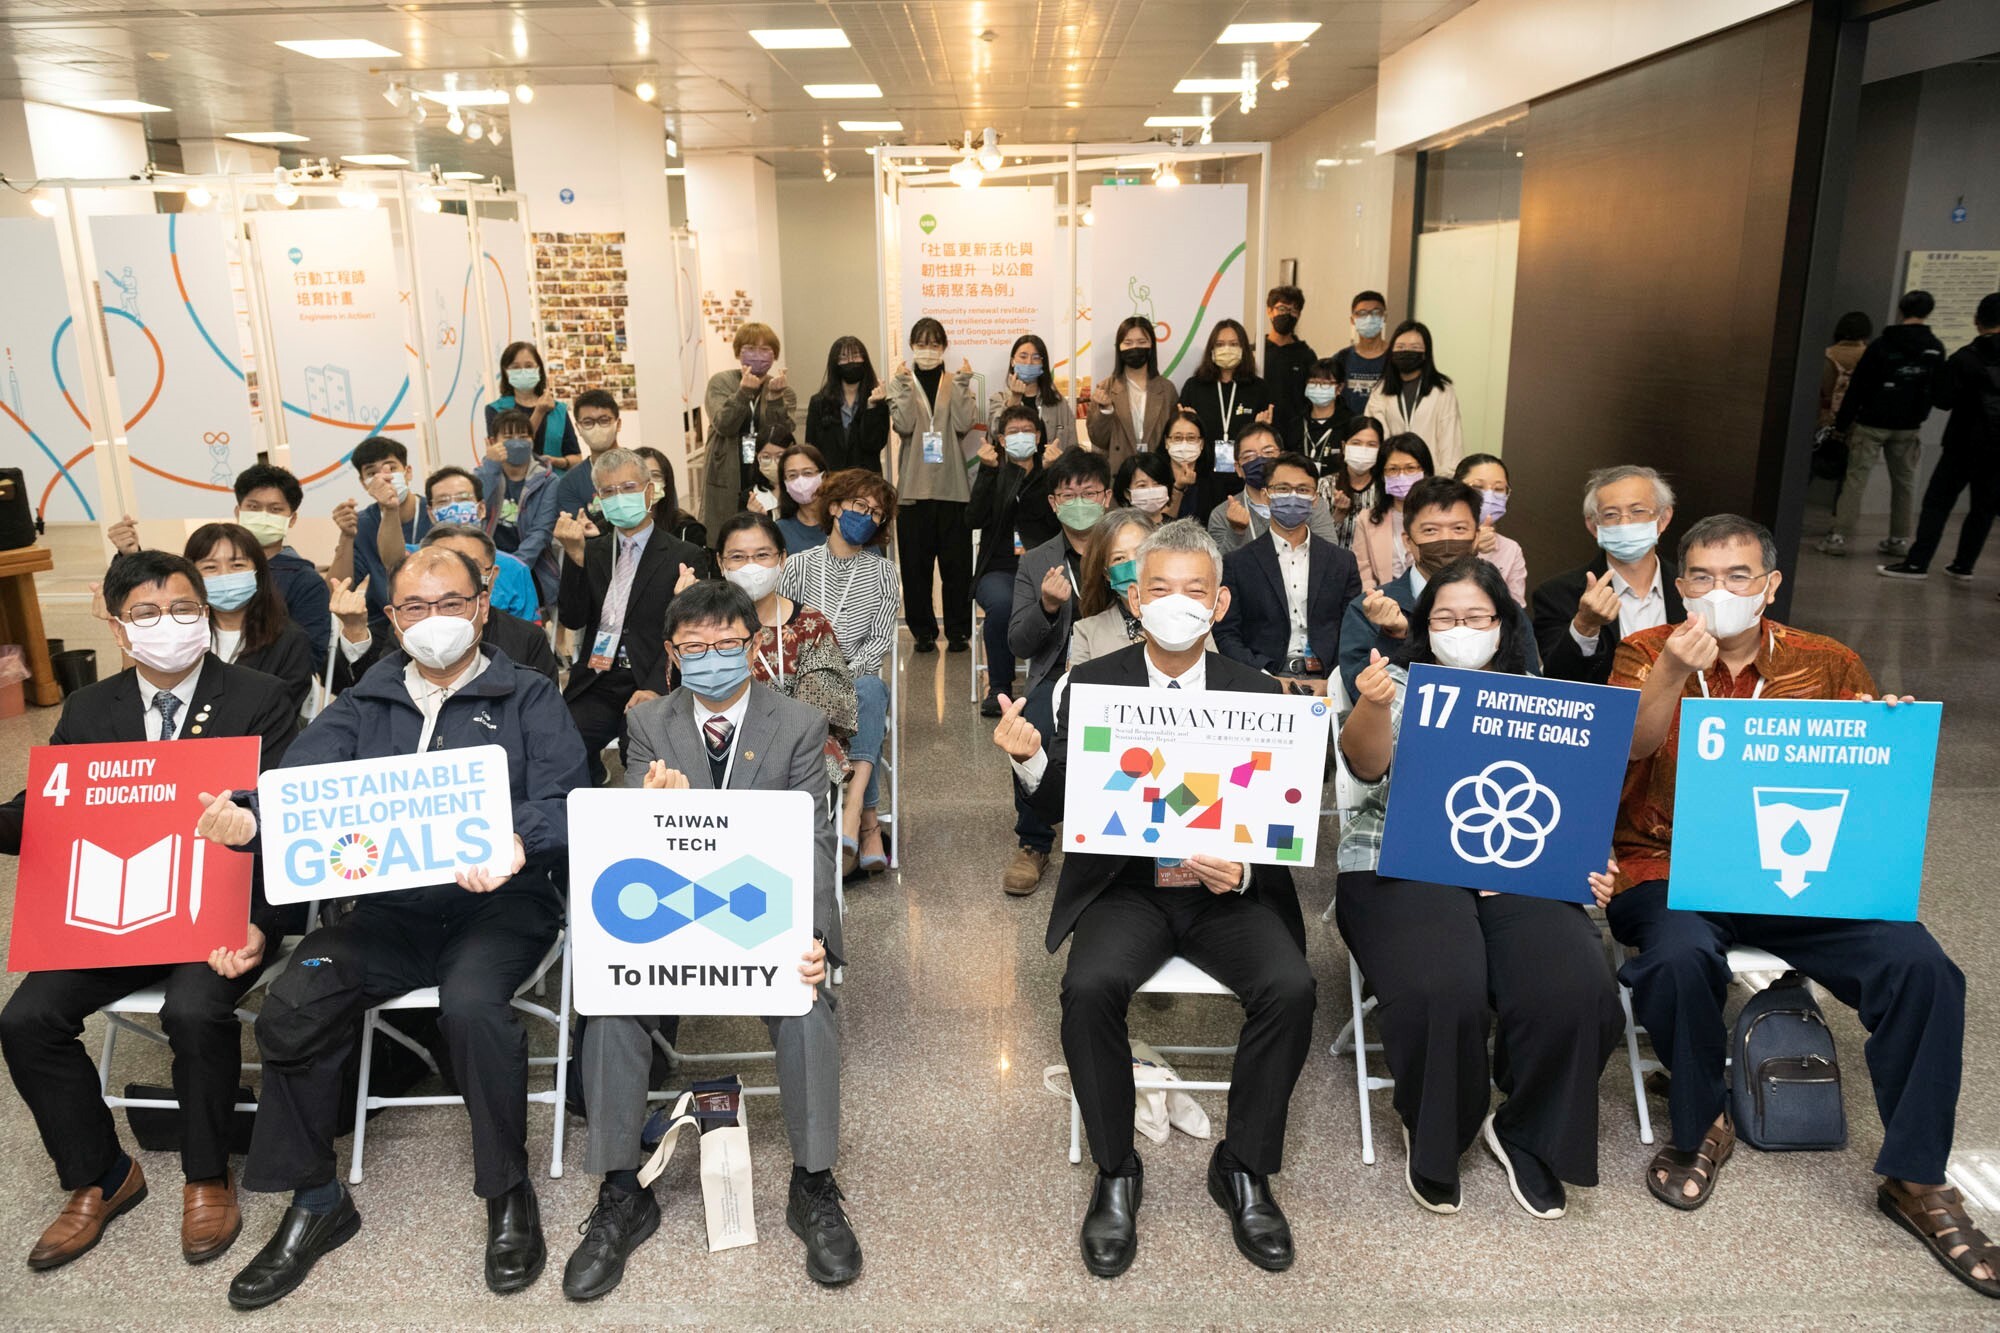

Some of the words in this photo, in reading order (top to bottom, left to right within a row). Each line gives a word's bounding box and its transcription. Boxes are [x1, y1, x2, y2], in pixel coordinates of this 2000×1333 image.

[293, 270, 366, 286] 行動工程師
[296, 290, 353, 306] 培育計畫
[299, 313, 338, 322] Engineers
[921, 307, 967, 316] Community
[955, 317, 993, 325] resilience
[994, 316, 1030, 324] elevation
[953, 338, 988, 346] southern
[989, 338, 1012, 347] Taipei
[956, 327, 965, 335] of
[1417, 682, 1461, 729] 17
[1476, 689, 1596, 721] PARTNERSHIPS
[1113, 704, 1218, 729] TAIWAN
[1222, 709, 1297, 734] TECH
[1471, 714, 1503, 737] FOR
[1506, 719, 1537, 741] THE
[1538, 723, 1592, 748] GOALS
[1697, 716, 1726, 761] 6
[1744, 717, 1801, 737] CLEAN
[1806, 718, 1868, 738] WATER
[1741, 743, 1780, 762] AND
[1784, 744, 1891, 766] SANITATION
[42, 762, 71, 807] 4
[87, 758, 157, 781] QUALITY
[280, 761, 486, 806] SUSTAINABLE
[85, 783, 177, 806] EDUCATION
[282, 789, 487, 834] DEVELOPMENT
[653, 814, 729, 829] TAIWAN
[284, 816, 493, 887] GOALS
[666, 837, 717, 851] TECH
[607, 963, 642, 986] To
[648, 964, 779, 987] INFINITY
